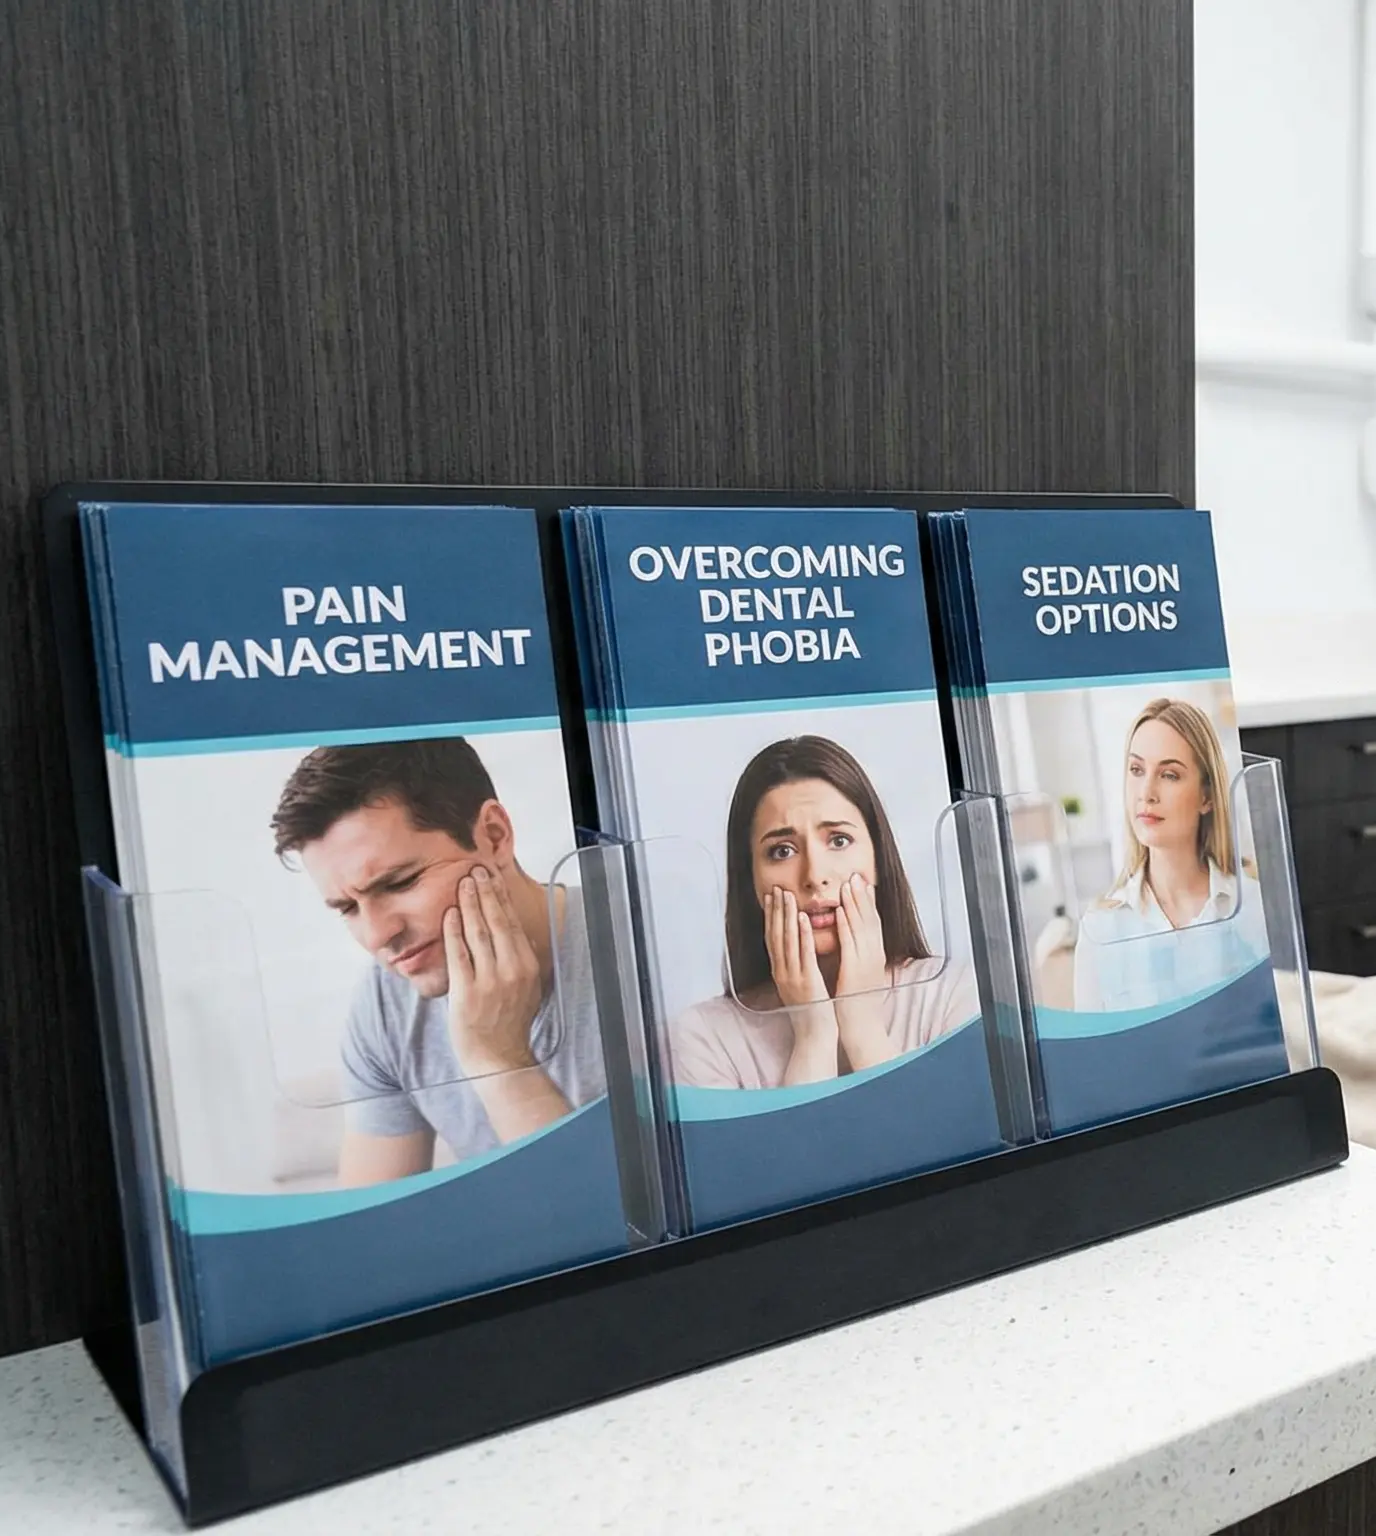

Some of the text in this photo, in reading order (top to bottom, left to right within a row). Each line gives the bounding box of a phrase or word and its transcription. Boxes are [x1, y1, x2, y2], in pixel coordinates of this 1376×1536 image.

[628, 544, 906, 583] OVERCOMING
[1021, 564, 1181, 598] SEDATION
[281, 585, 407, 626] PAIN
[700, 587, 855, 624] DENTAL
[1034, 600, 1179, 636] OPTIONS
[148, 628, 532, 683] MANAGEMENT
[705, 628, 862, 667] PHOBIA
